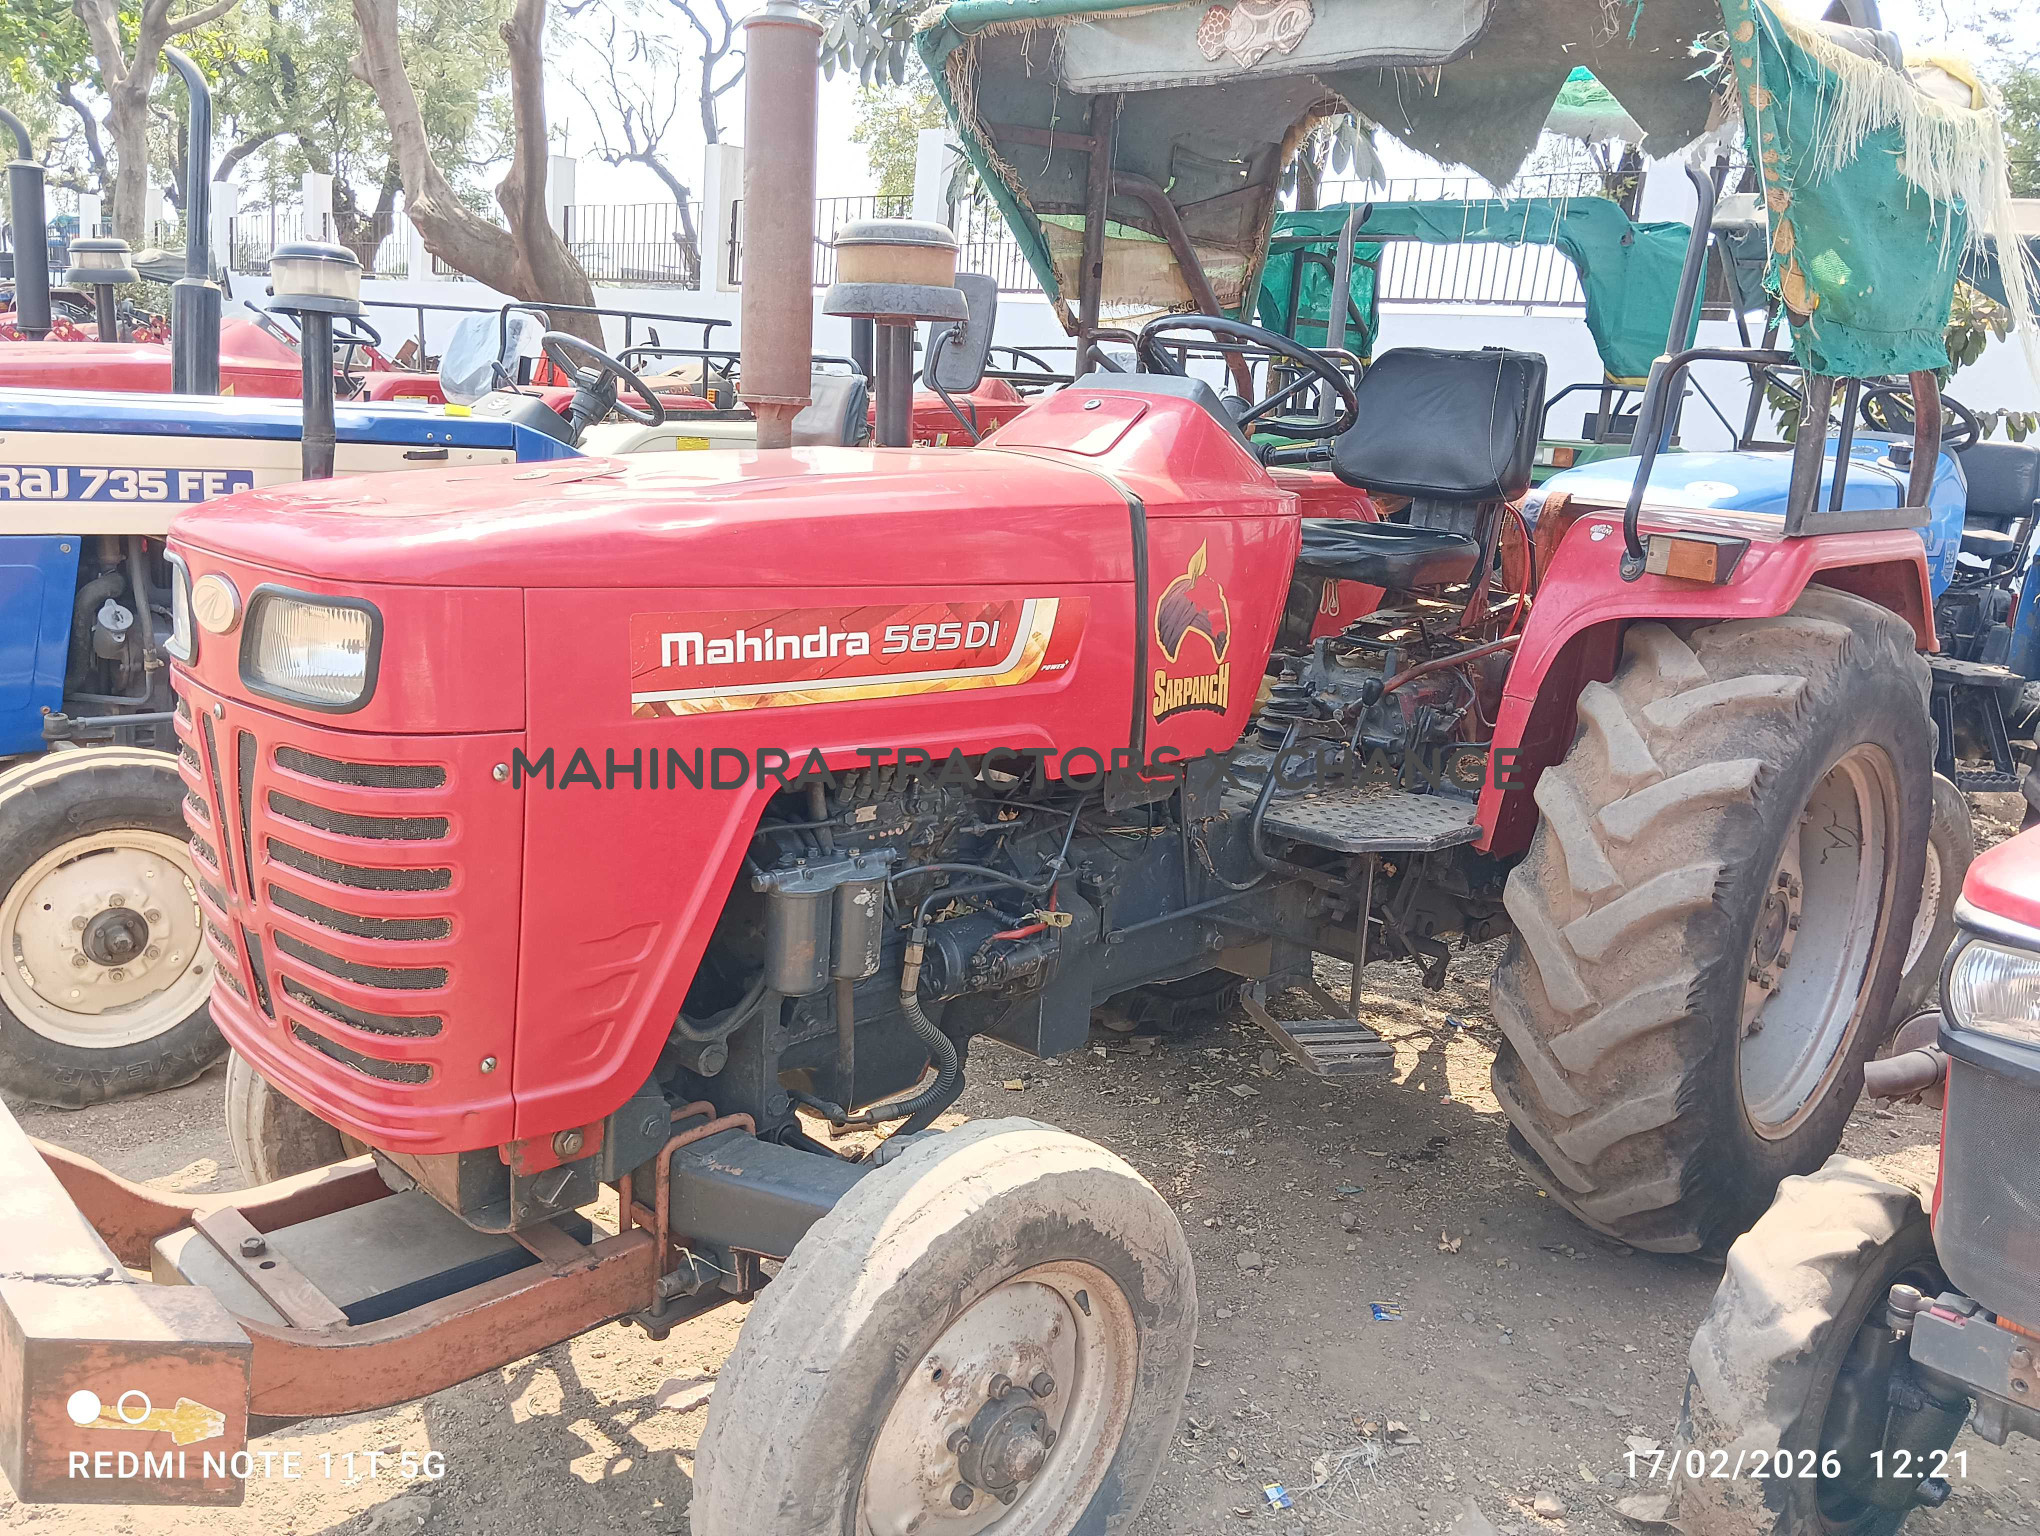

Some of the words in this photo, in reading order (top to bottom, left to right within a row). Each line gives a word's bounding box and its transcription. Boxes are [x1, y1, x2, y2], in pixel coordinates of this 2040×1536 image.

[79, 469, 169, 500] 735
[661, 625, 870, 668] Mahindra
[1153, 662, 1230, 719] SARPANCH
